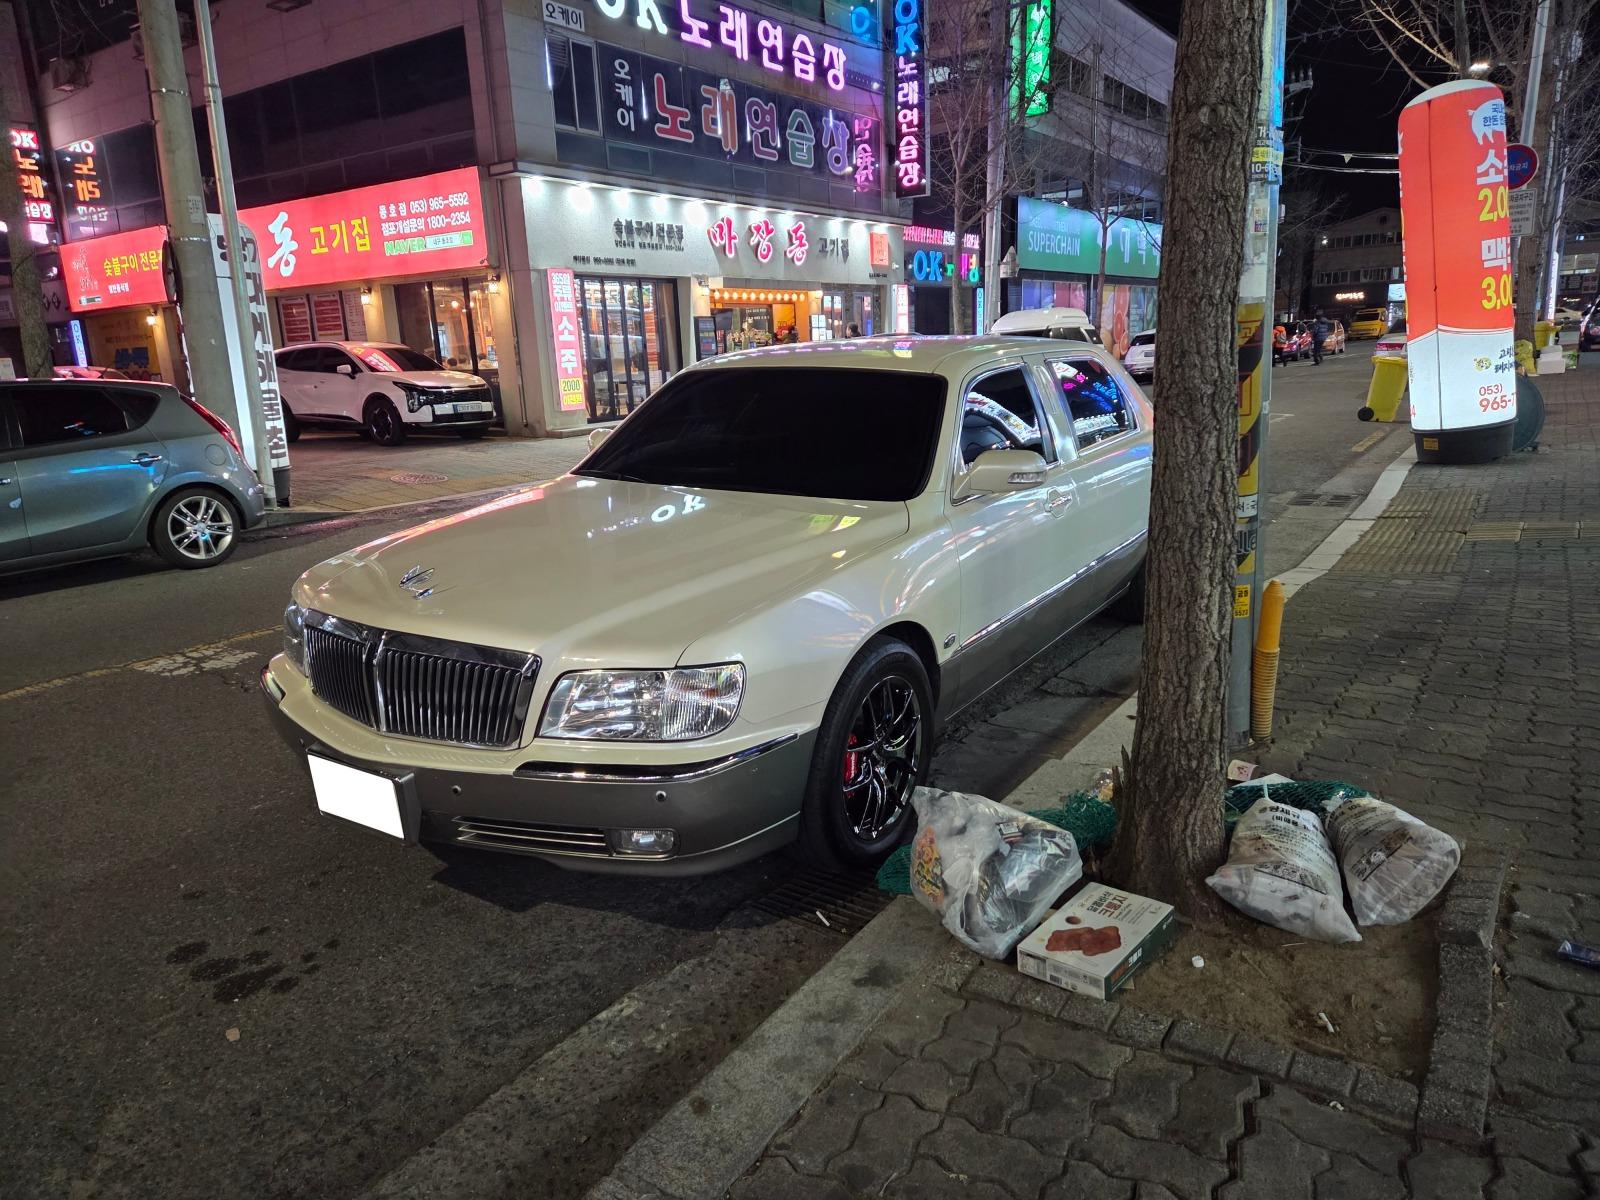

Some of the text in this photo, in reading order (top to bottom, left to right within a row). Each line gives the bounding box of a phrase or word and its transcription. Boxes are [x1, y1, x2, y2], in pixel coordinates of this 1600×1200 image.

[545, 4, 583, 30] 오케이
[680, 0, 846, 91] 노래연습장
[614, 58, 636, 132] 오케이
[655, 73, 849, 175] 노래연습장
[897, 55, 920, 187] 노래연습장
[1477, 149, 1508, 185] 소
[429, 192, 469, 210] 965-5592
[1477, 186, 1510, 222] 2,0
[310, 216, 371, 255] 고기집
[427, 210, 471, 229] 1800-2354
[384, 236, 426, 256] NAVER
[707, 216, 809, 266] 마장동
[1028, 230, 1081, 257] SUPERCHAIN
[1481, 237, 1511, 271] 맥
[103, 253, 140, 277] 숯불구이
[913, 250, 943, 282] OK
[562, 379, 581, 391] 2000
[1478, 383, 1503, 397] 053)
